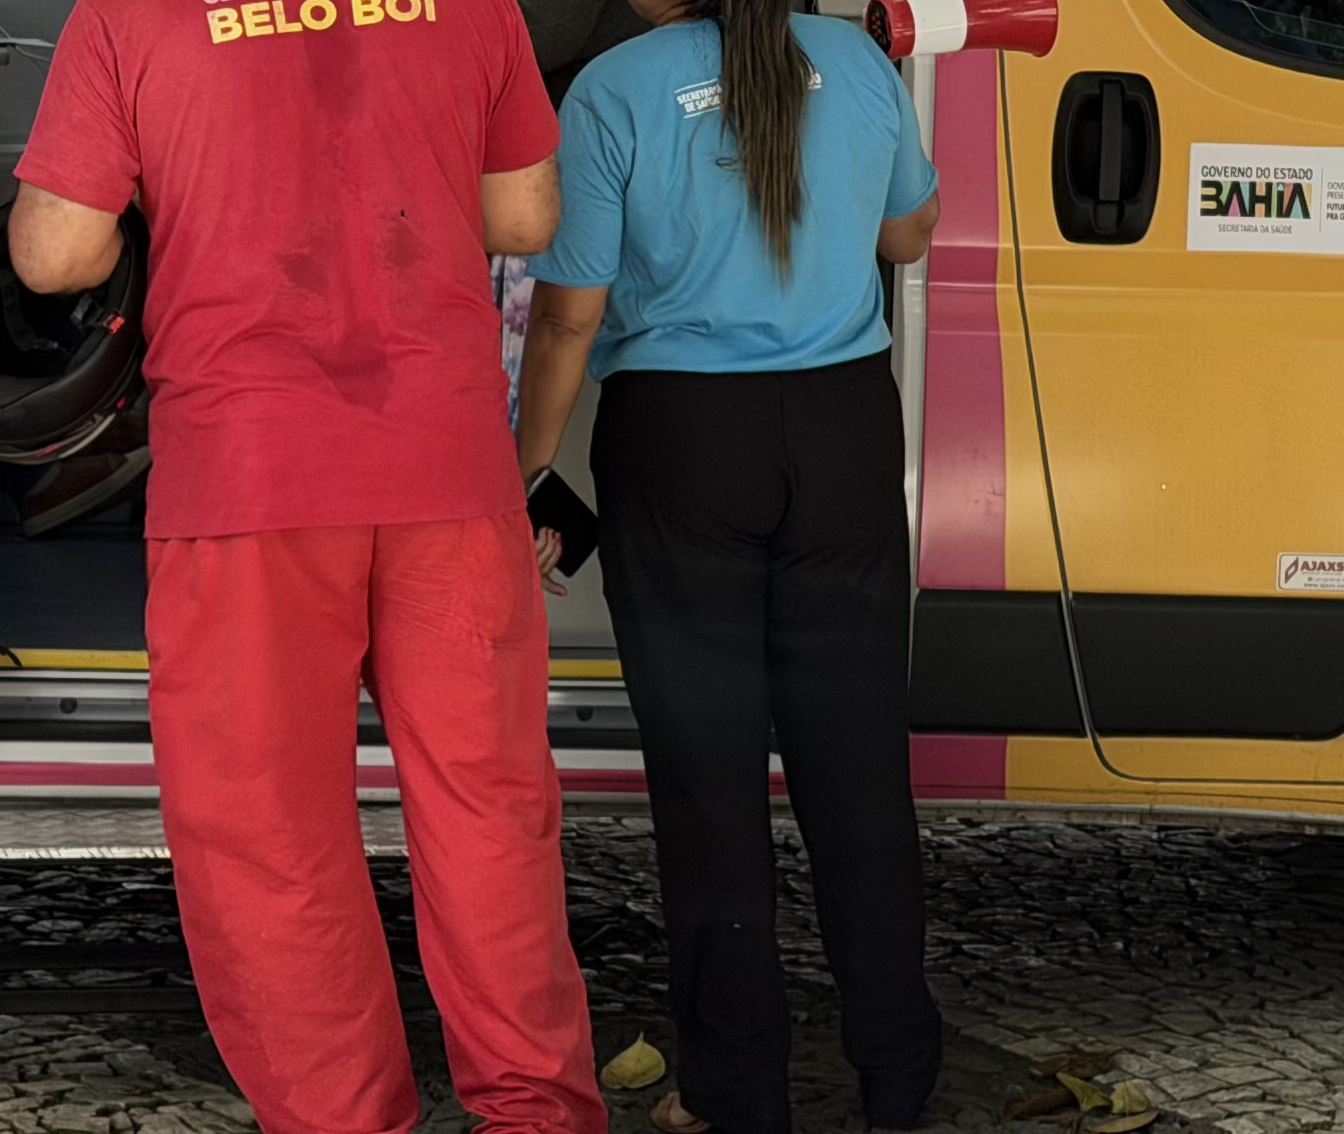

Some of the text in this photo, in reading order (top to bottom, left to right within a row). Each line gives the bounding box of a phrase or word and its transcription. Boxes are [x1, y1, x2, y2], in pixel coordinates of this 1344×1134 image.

[1201, 165, 1313, 180] GOVERNO DO ESTADO
[1200, 179, 1312, 219] BAHIA
[1326, 212, 1338, 221] PRA
[1218, 224, 1293, 234] SECRETARIA DA SAÚDE
